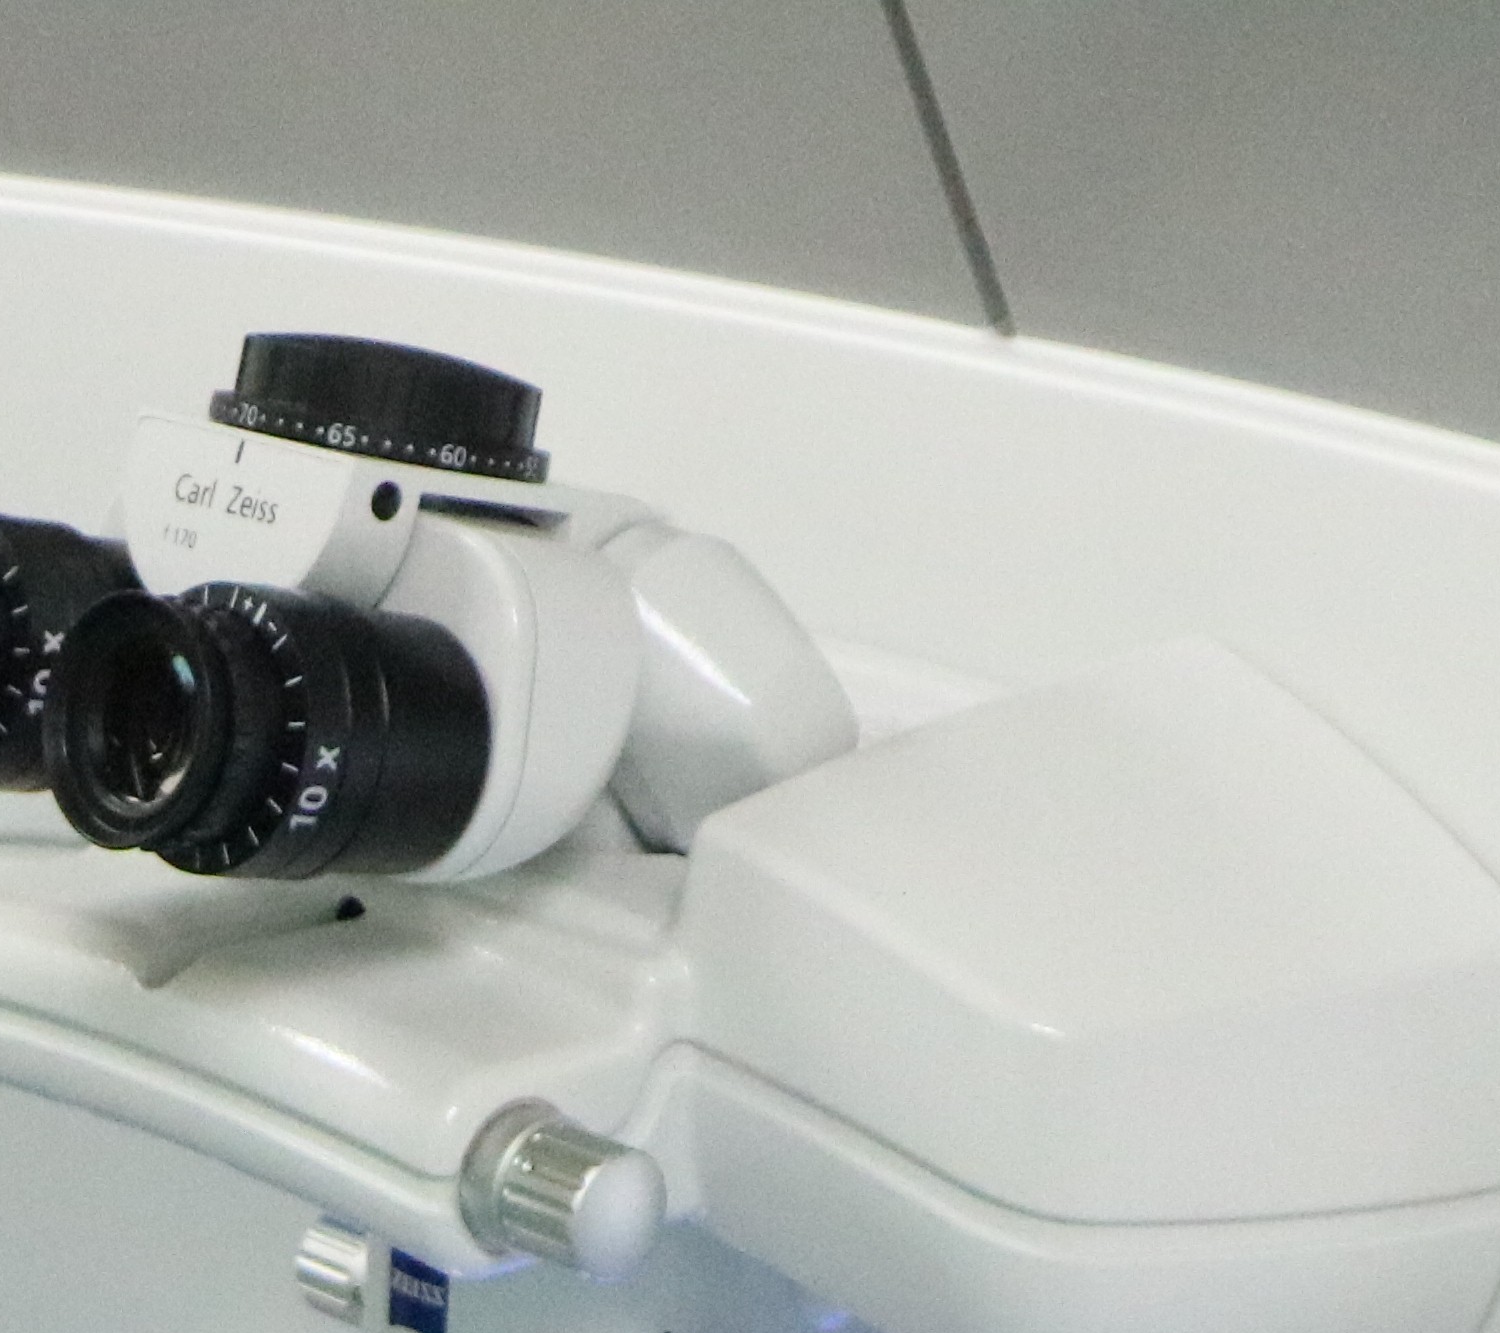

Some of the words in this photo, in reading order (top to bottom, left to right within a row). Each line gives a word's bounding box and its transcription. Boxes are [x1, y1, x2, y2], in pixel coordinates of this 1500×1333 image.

[239, 402, 258, 426] 70
[327, 423, 356, 447] 65
[441, 443, 467, 468] 60
[175, 473, 218, 508] Carl
[225, 485, 279, 524] Zeiss
